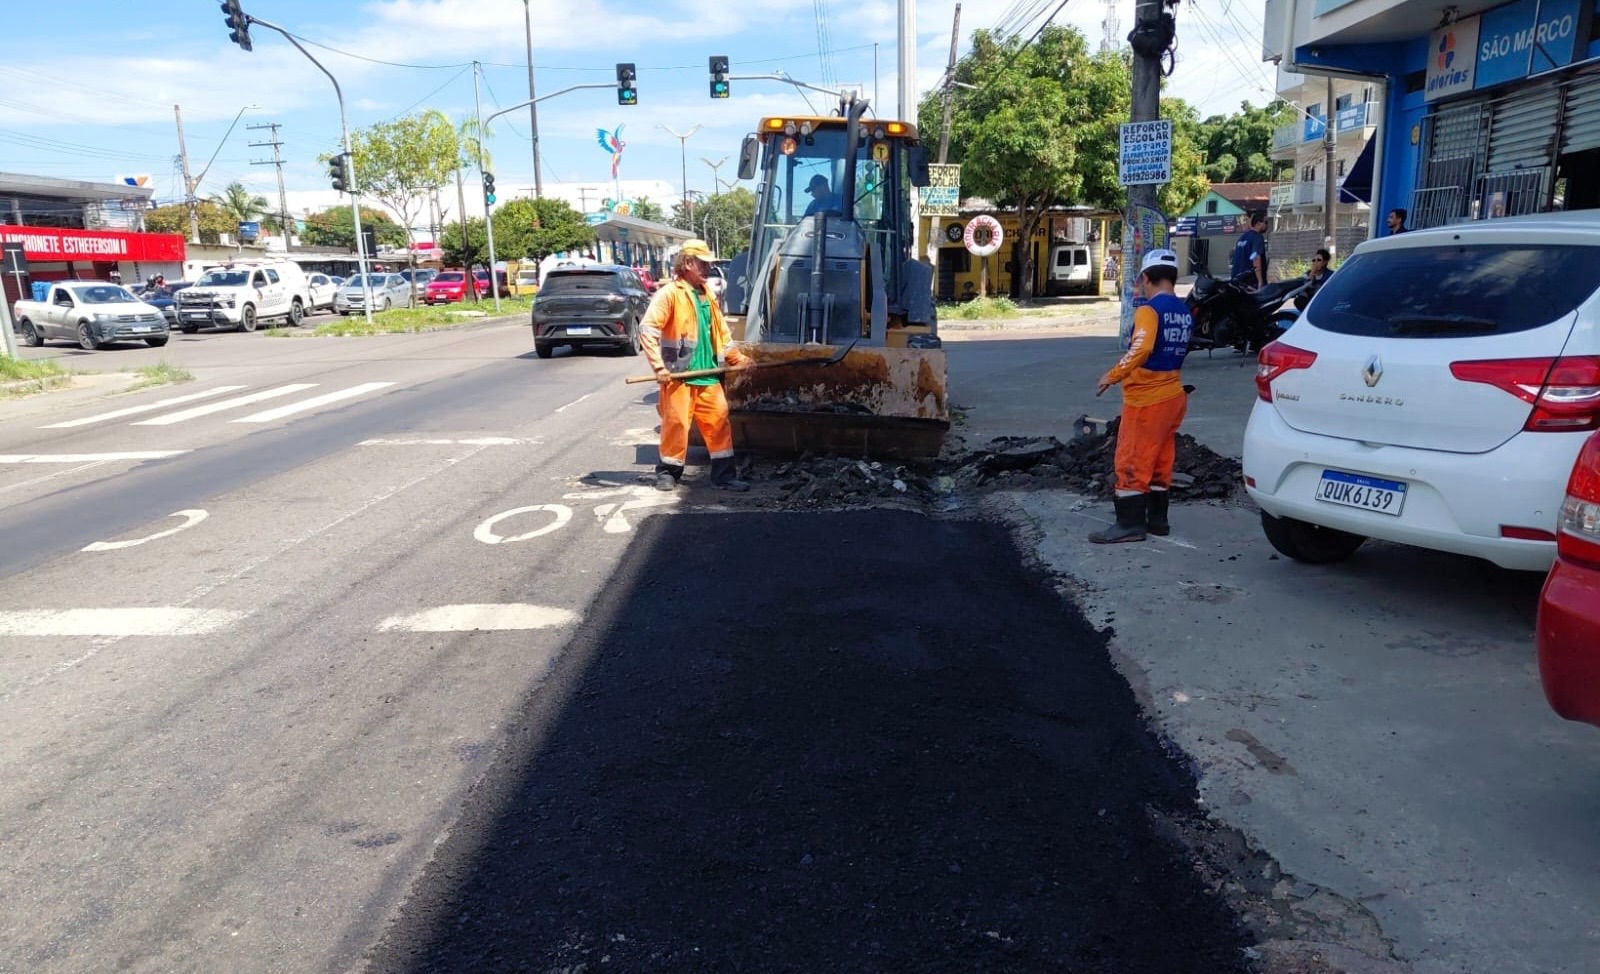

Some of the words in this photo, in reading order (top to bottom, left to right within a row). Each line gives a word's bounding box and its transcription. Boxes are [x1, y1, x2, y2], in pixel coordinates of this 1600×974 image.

[1481, 35, 1510, 61] SÃO
[1513, 15, 1572, 53] MARCO
[1124, 131, 1169, 143] ESCOLAR
[1163, 313, 1192, 325] PLANO
[1339, 393, 1405, 406] SANDERO
